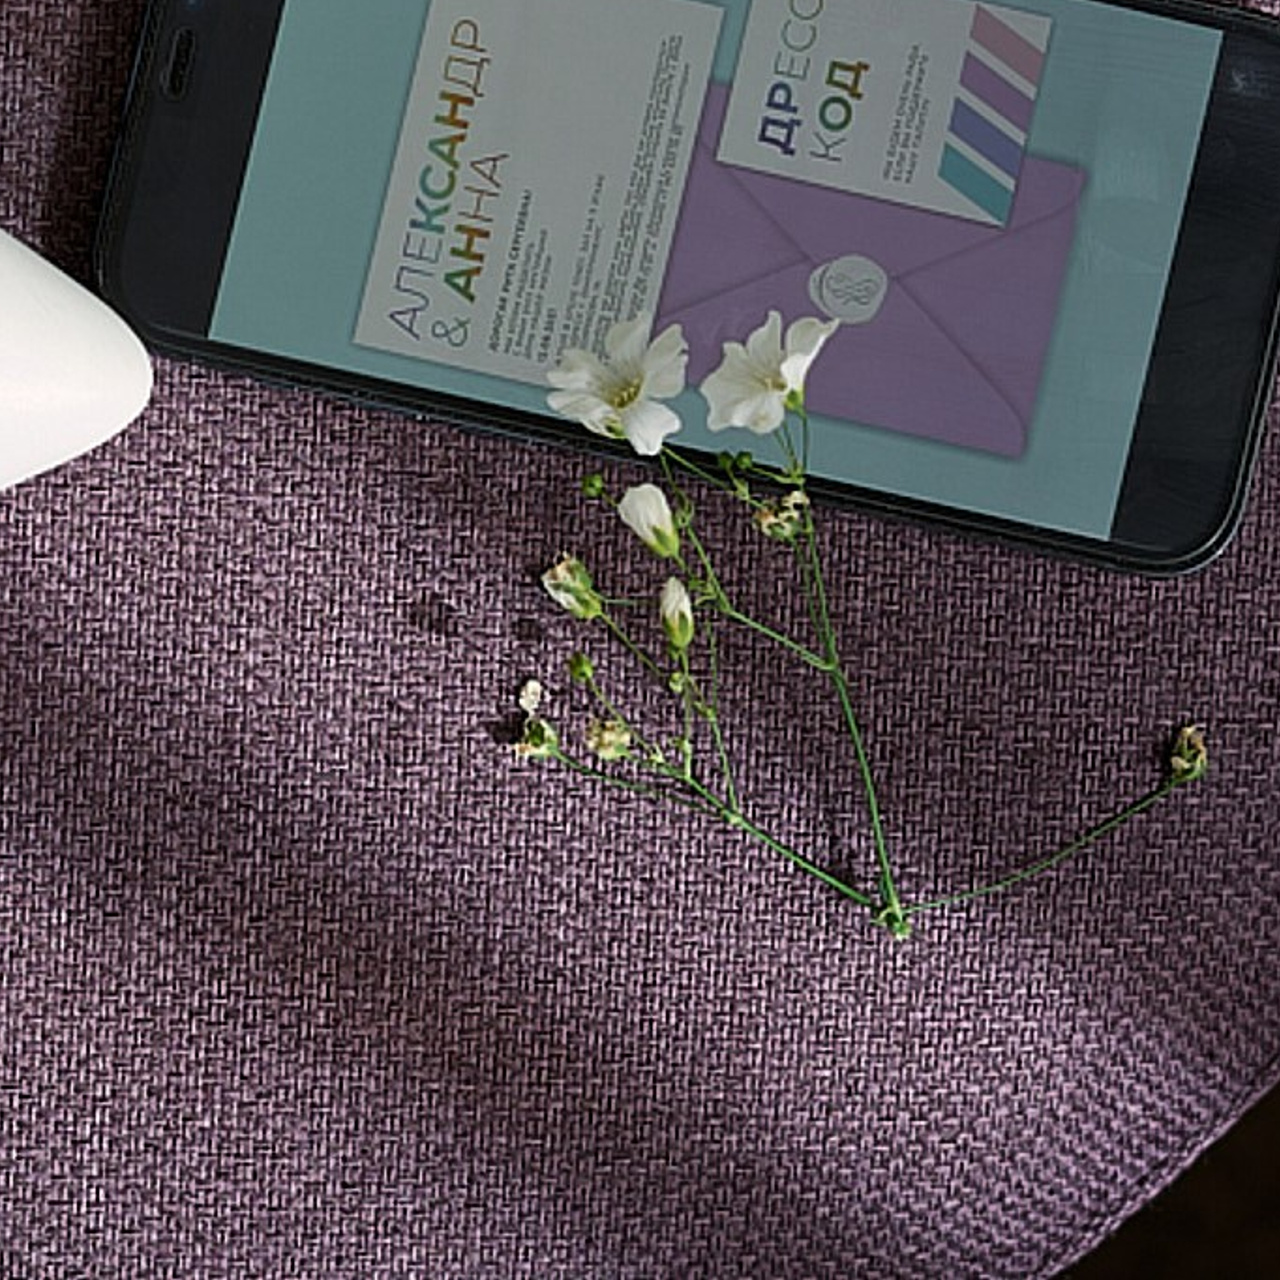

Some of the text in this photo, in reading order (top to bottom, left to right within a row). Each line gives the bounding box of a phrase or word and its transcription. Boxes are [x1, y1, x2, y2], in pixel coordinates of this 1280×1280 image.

[387, 19, 492, 341] АЛЕКСАНДР
[808, 59, 871, 163] КОД
[430, 153, 510, 348] & АННА
